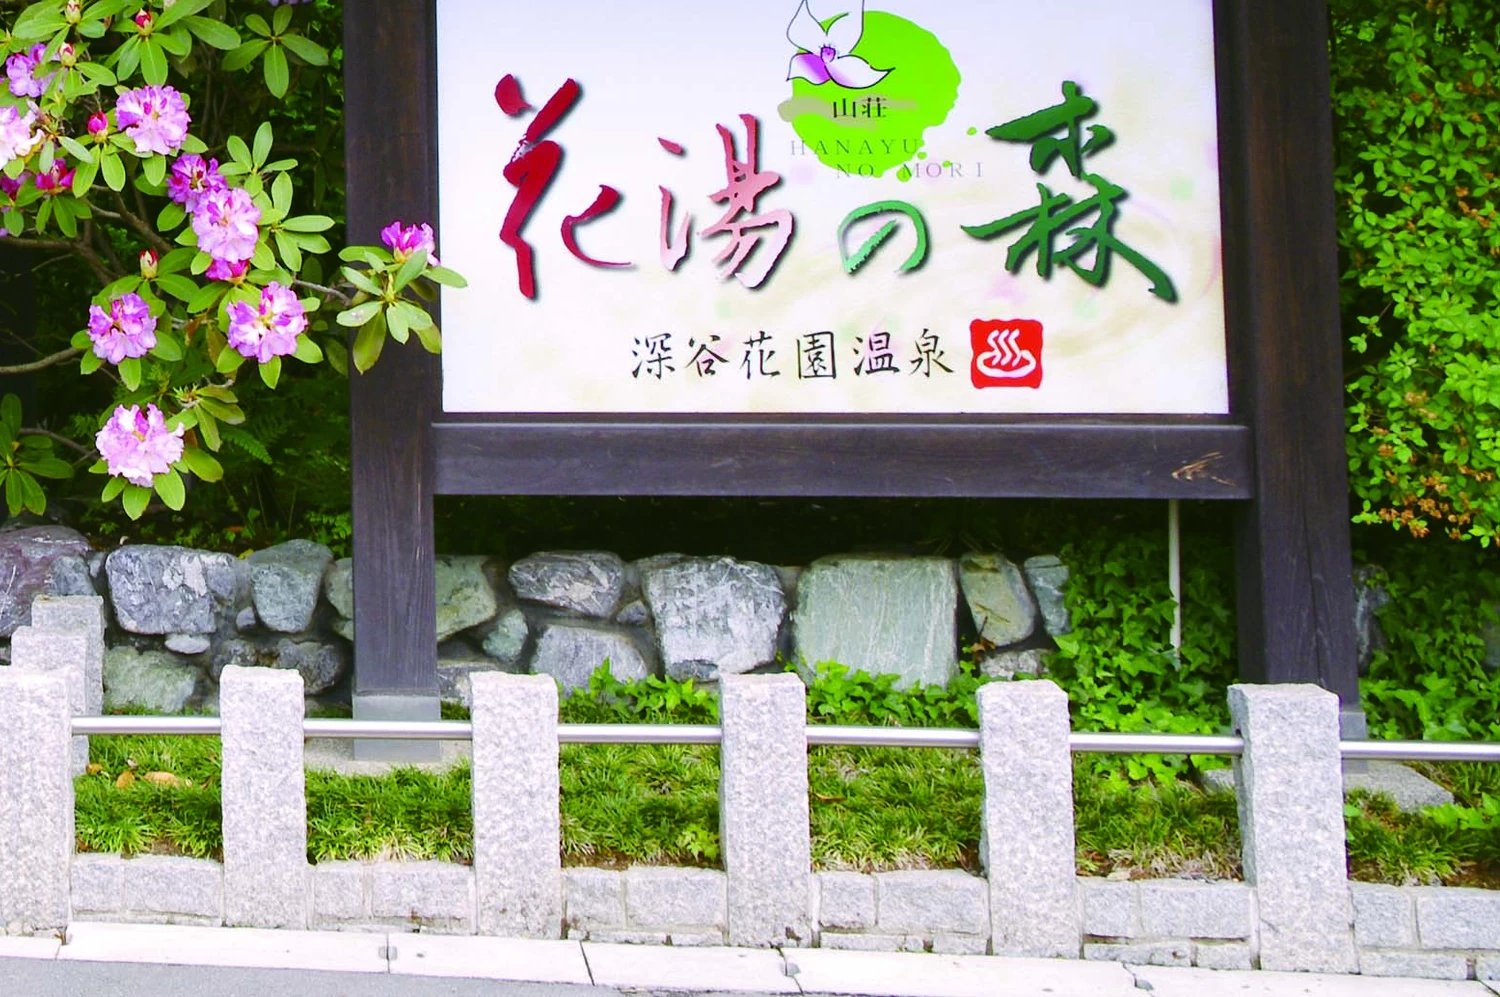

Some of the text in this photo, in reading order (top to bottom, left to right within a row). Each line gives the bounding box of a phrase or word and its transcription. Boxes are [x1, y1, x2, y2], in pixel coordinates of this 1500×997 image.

[833, 96, 887, 118] 山荘
[790, 139, 919, 155] HANAYU
[837, 161, 984, 178] NO MORI
[494, 73, 1179, 301] 花湯の森
[631, 328, 955, 380] 深谷花園温泉
